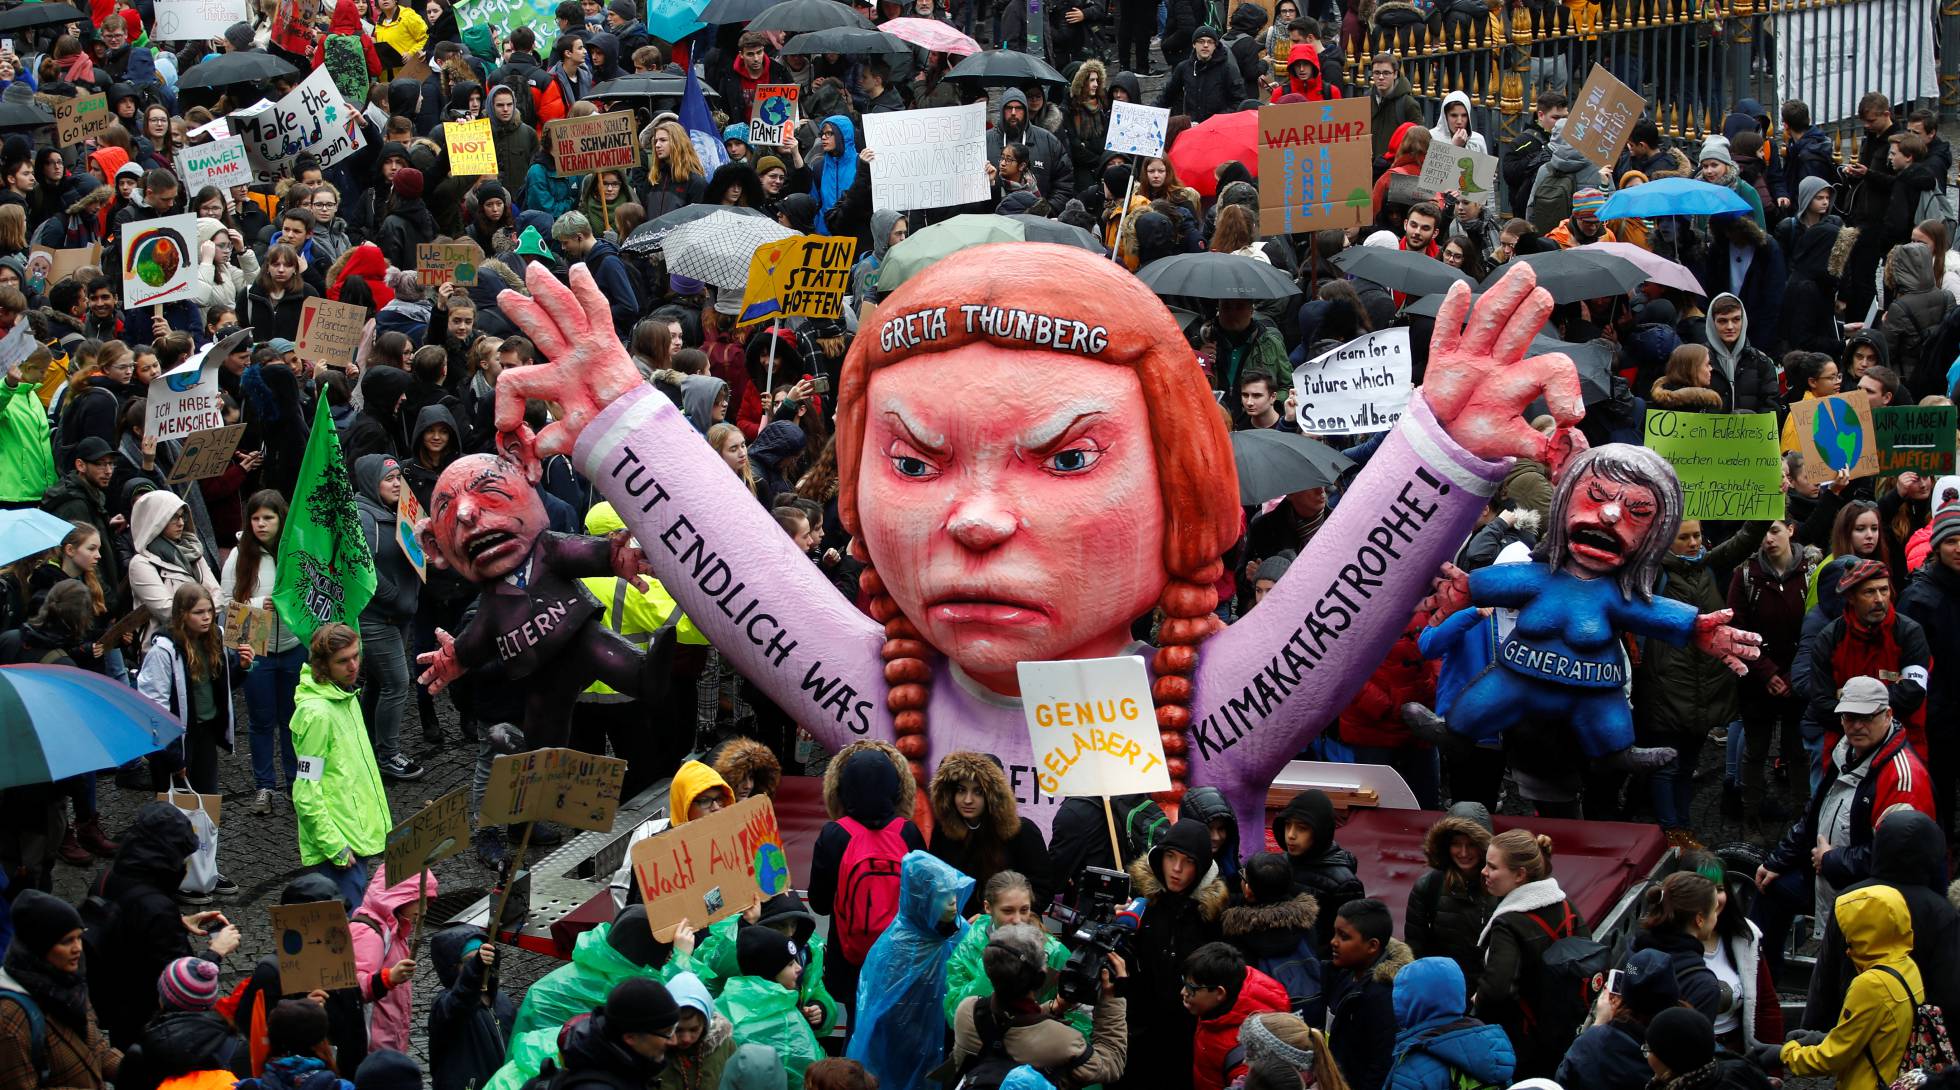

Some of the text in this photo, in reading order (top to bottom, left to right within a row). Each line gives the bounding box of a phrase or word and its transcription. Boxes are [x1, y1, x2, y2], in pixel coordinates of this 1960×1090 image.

[780, 88, 799, 101] NO
[57, 105, 73, 119] GO
[234, 86, 331, 143] Make the
[1571, 85, 1605, 141] WAS SOLL
[1592, 107, 1613, 133] DER
[63, 115, 108, 142] GO HOME!
[446, 120, 490, 132] SYSTEM
[751, 120, 783, 143] PLANET
[1264, 121, 1365, 149] WARUM?
[452, 141, 487, 153] NOT
[558, 132, 632, 155] IHR SCHWÄNZT
[187, 144, 244, 172] UMWELT
[207, 162, 239, 177] BANK
[560, 145, 635, 172] VERANTWORTUNG!
[419, 245, 440, 261] We
[802, 242, 851, 268] TUN
[418, 268, 454, 285] TIME
[784, 267, 849, 291] STATT
[781, 290, 844, 315] HOTTEN
[880, 304, 1109, 355] GRETA THUNBERG
[1336, 336, 1401, 361] learn for a
[1304, 366, 1395, 396] future which
[155, 396, 212, 419] ICH HABE
[1301, 402, 1347, 430] Soon
[1350, 403, 1368, 427] will
[1370, 402, 1386, 426] be
[1796, 410, 1812, 426] WE
[158, 411, 219, 437] MENSCHEN
[1690, 426, 1707, 439] ein
[1875, 410, 1948, 431] WIR HABEN
[1893, 431, 1935, 447] KEINEN
[1709, 479, 1767, 493] nachhaltige
[611, 446, 874, 735] TUT ENDLICH WAS
[1190, 466, 1452, 761] KLIMAKATASTROPHE!
[496, 598, 578, 661] ELTERN-
[1504, 640, 1622, 681] GENERATION
[1035, 697, 1139, 727] GENUG
[511, 755, 536, 774] DIE
[1038, 727, 1162, 793] GELABERT
[639, 839, 695, 903] Wacht
